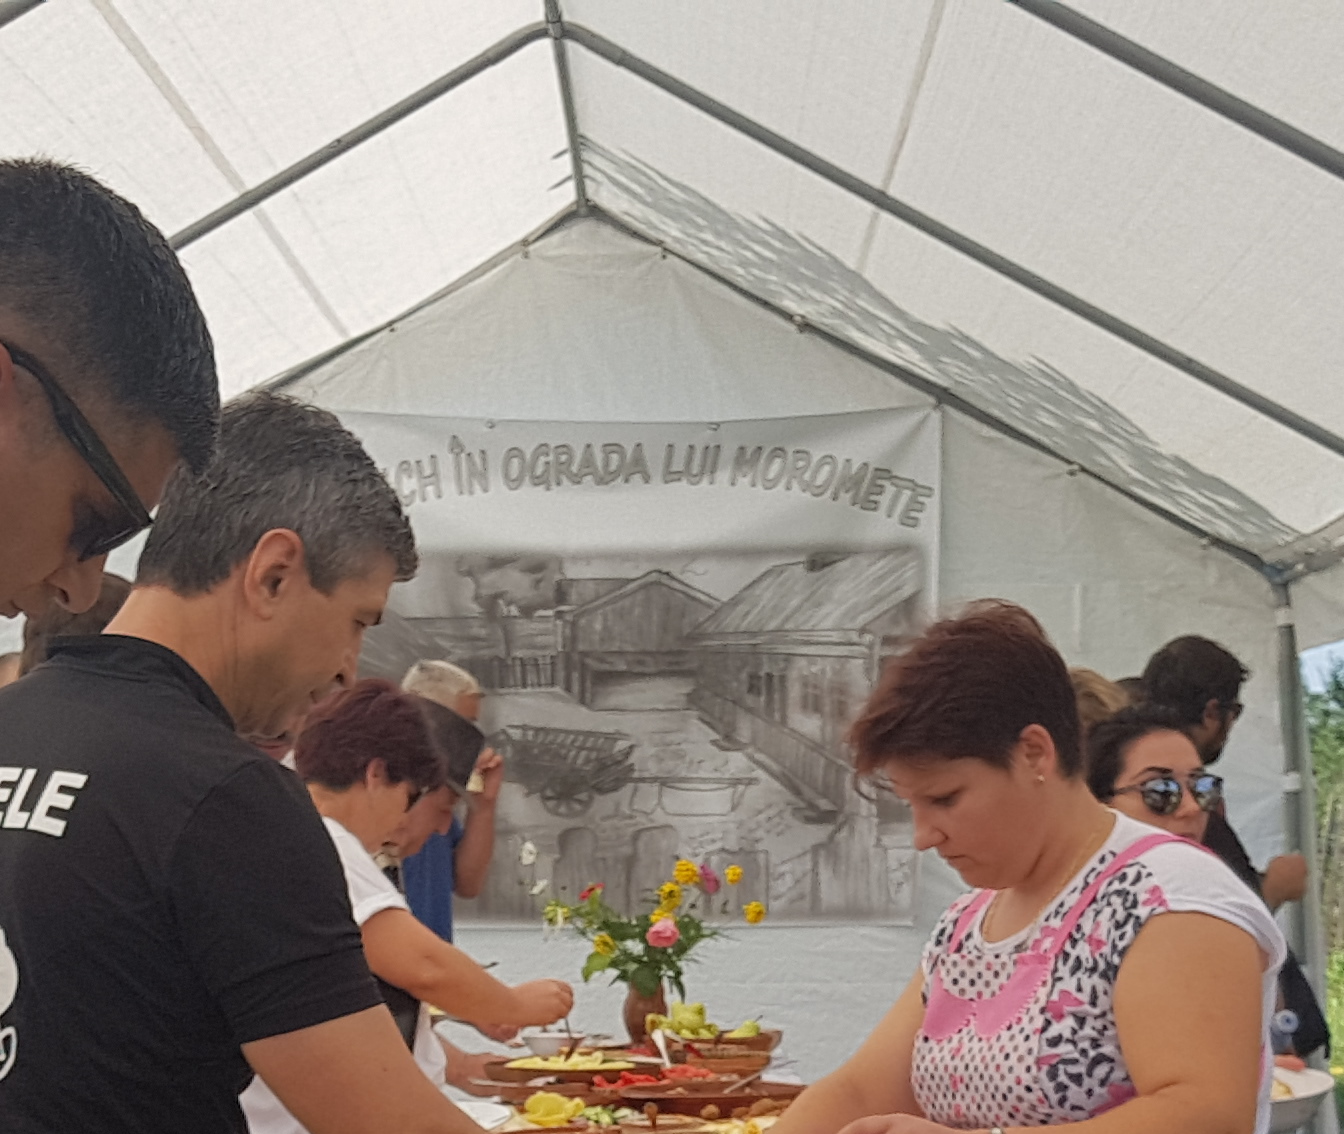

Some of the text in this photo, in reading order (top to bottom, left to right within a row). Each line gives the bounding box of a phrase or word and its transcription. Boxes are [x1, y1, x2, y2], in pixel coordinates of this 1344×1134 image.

[393, 434, 935, 529] CH ÎN OGRADA LUI MOROMETE
